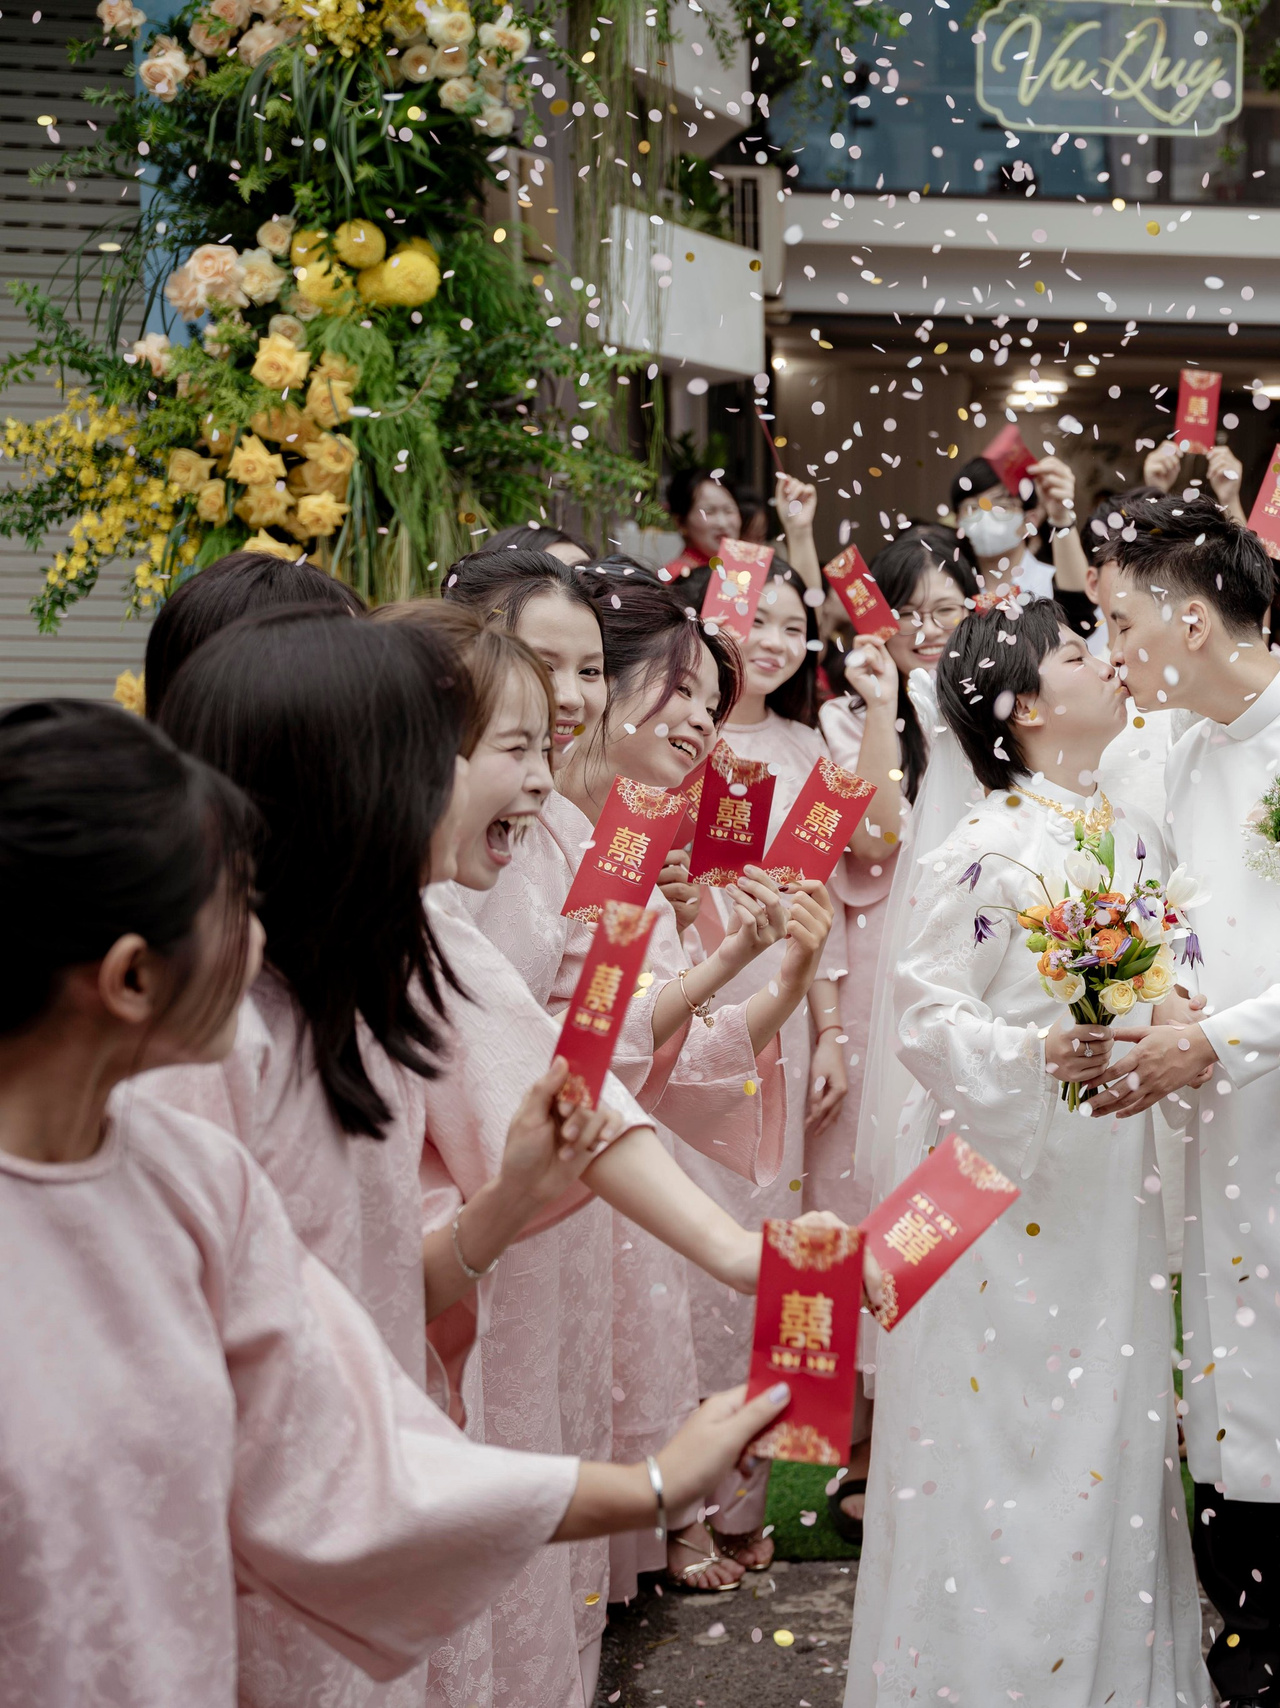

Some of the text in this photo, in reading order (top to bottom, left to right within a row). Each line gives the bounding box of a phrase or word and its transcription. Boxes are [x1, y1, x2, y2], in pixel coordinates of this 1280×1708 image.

[991, 14, 1227, 125] Vu Quy
[803, 801, 843, 840] 囍
[607, 826, 651, 868] 囍
